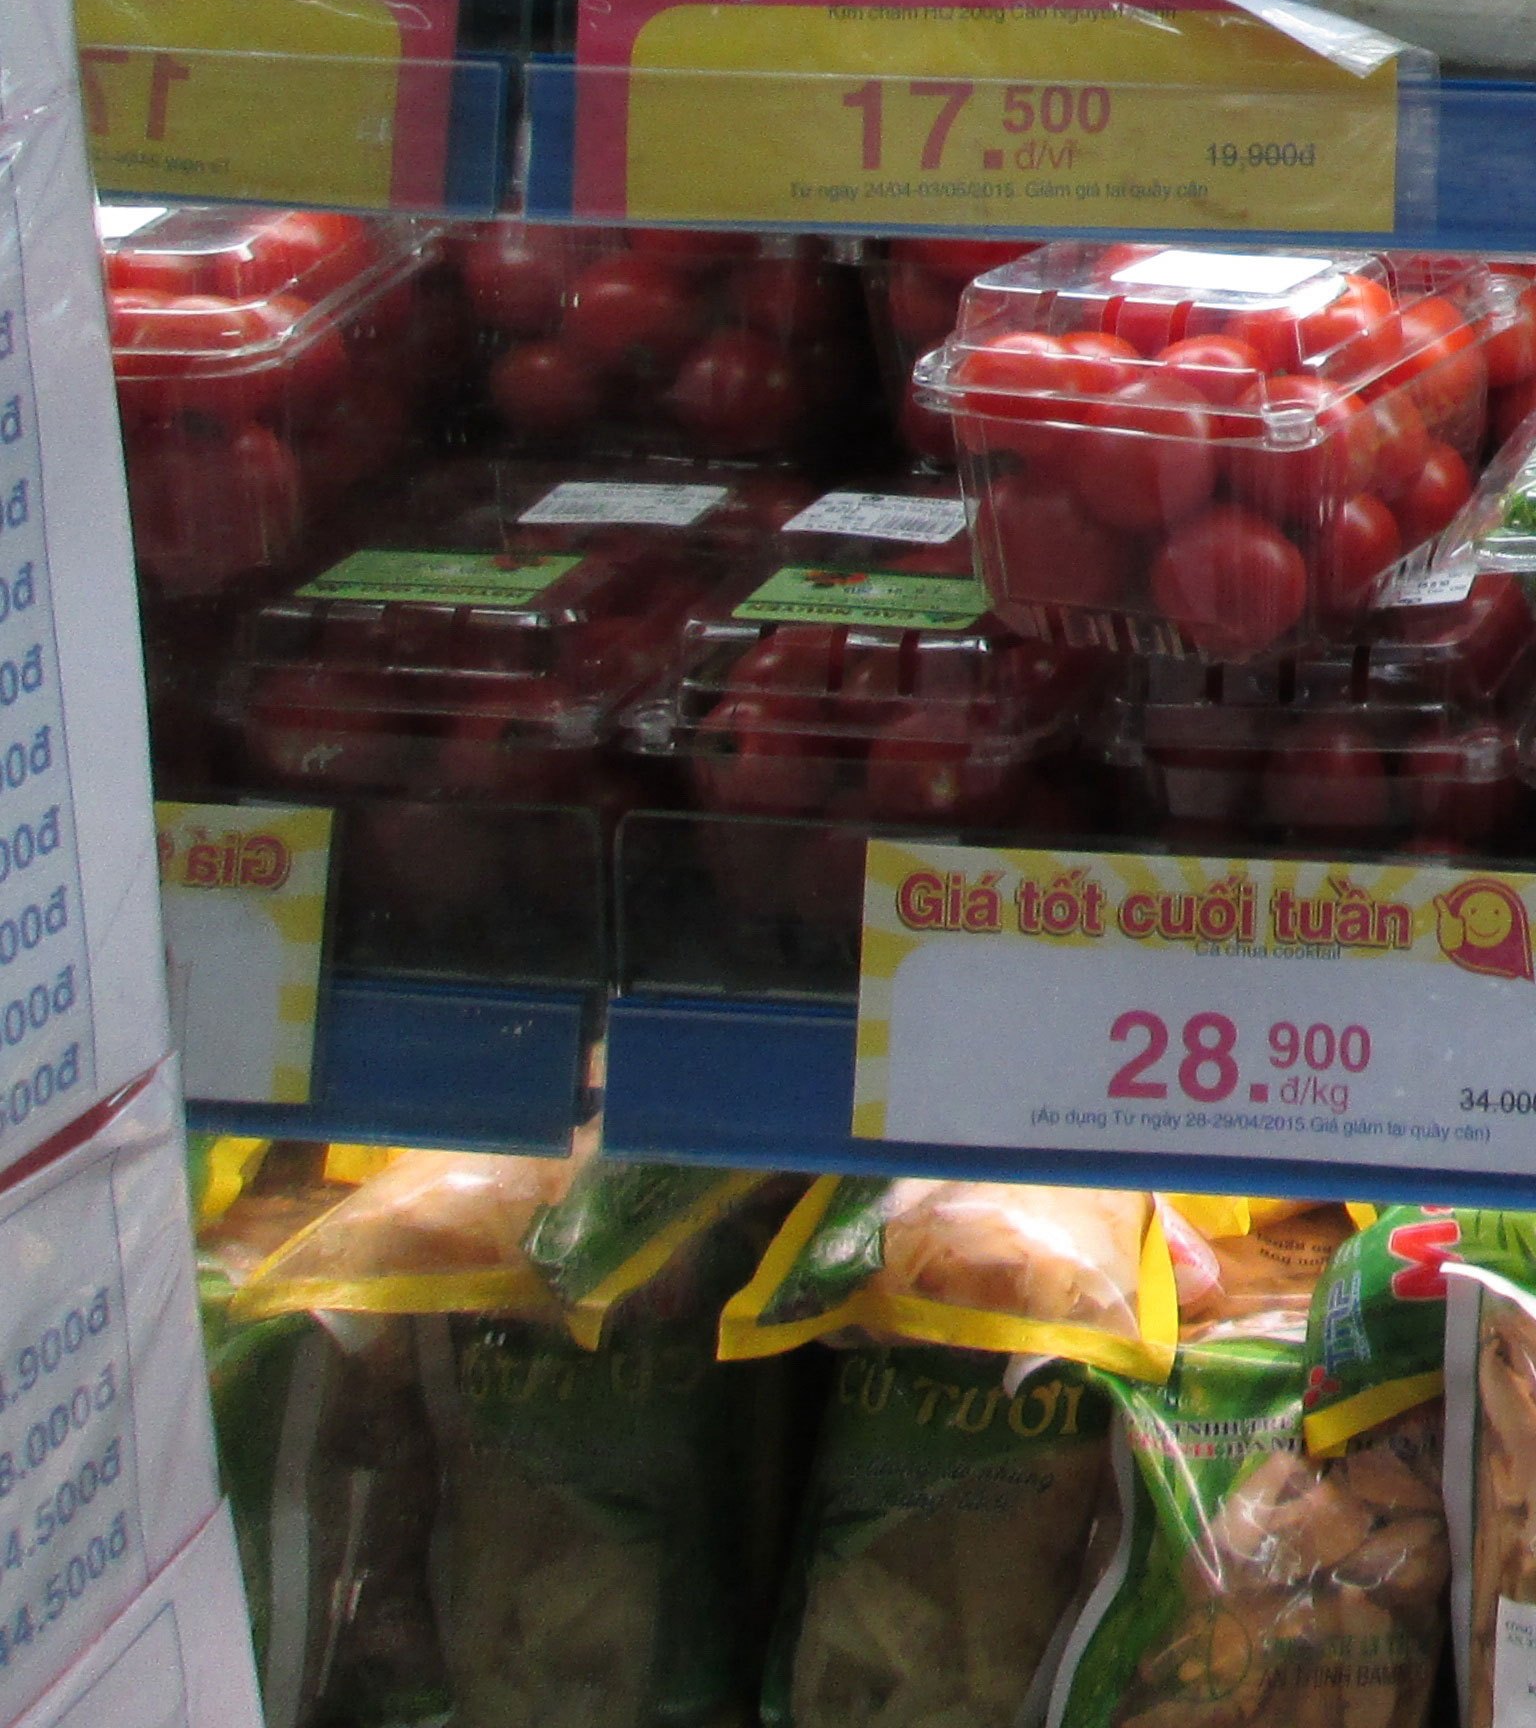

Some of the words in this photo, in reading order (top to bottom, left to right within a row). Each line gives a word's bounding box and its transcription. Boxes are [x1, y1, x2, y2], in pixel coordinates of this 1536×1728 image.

[895, 869, 1004, 935] Giá
[1015, 868, 1108, 938] tốt
[1118, 876, 1258, 944] cuối
[1269, 875, 1416, 951] tuần
